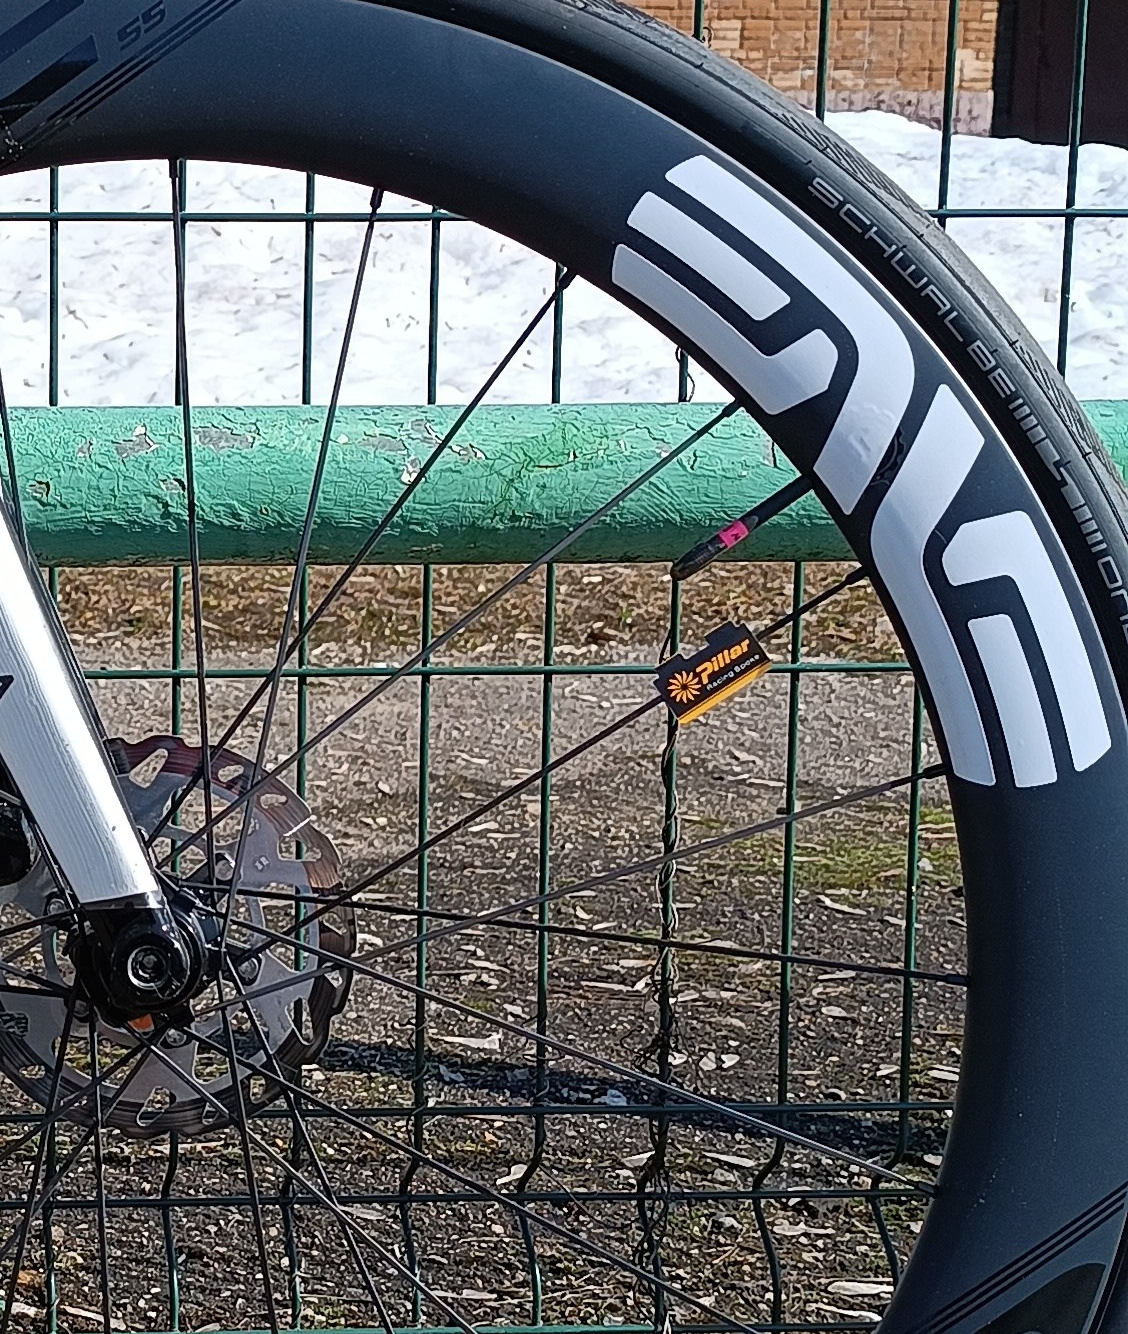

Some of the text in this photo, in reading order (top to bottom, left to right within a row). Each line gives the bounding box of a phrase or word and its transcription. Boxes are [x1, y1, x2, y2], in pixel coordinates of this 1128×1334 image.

[808, 176, 1016, 398] SCHWALBE
[611, 154, 1113, 789] ENVE
[695, 638, 750, 685] Pillar
[706, 670, 734, 691] Racing
